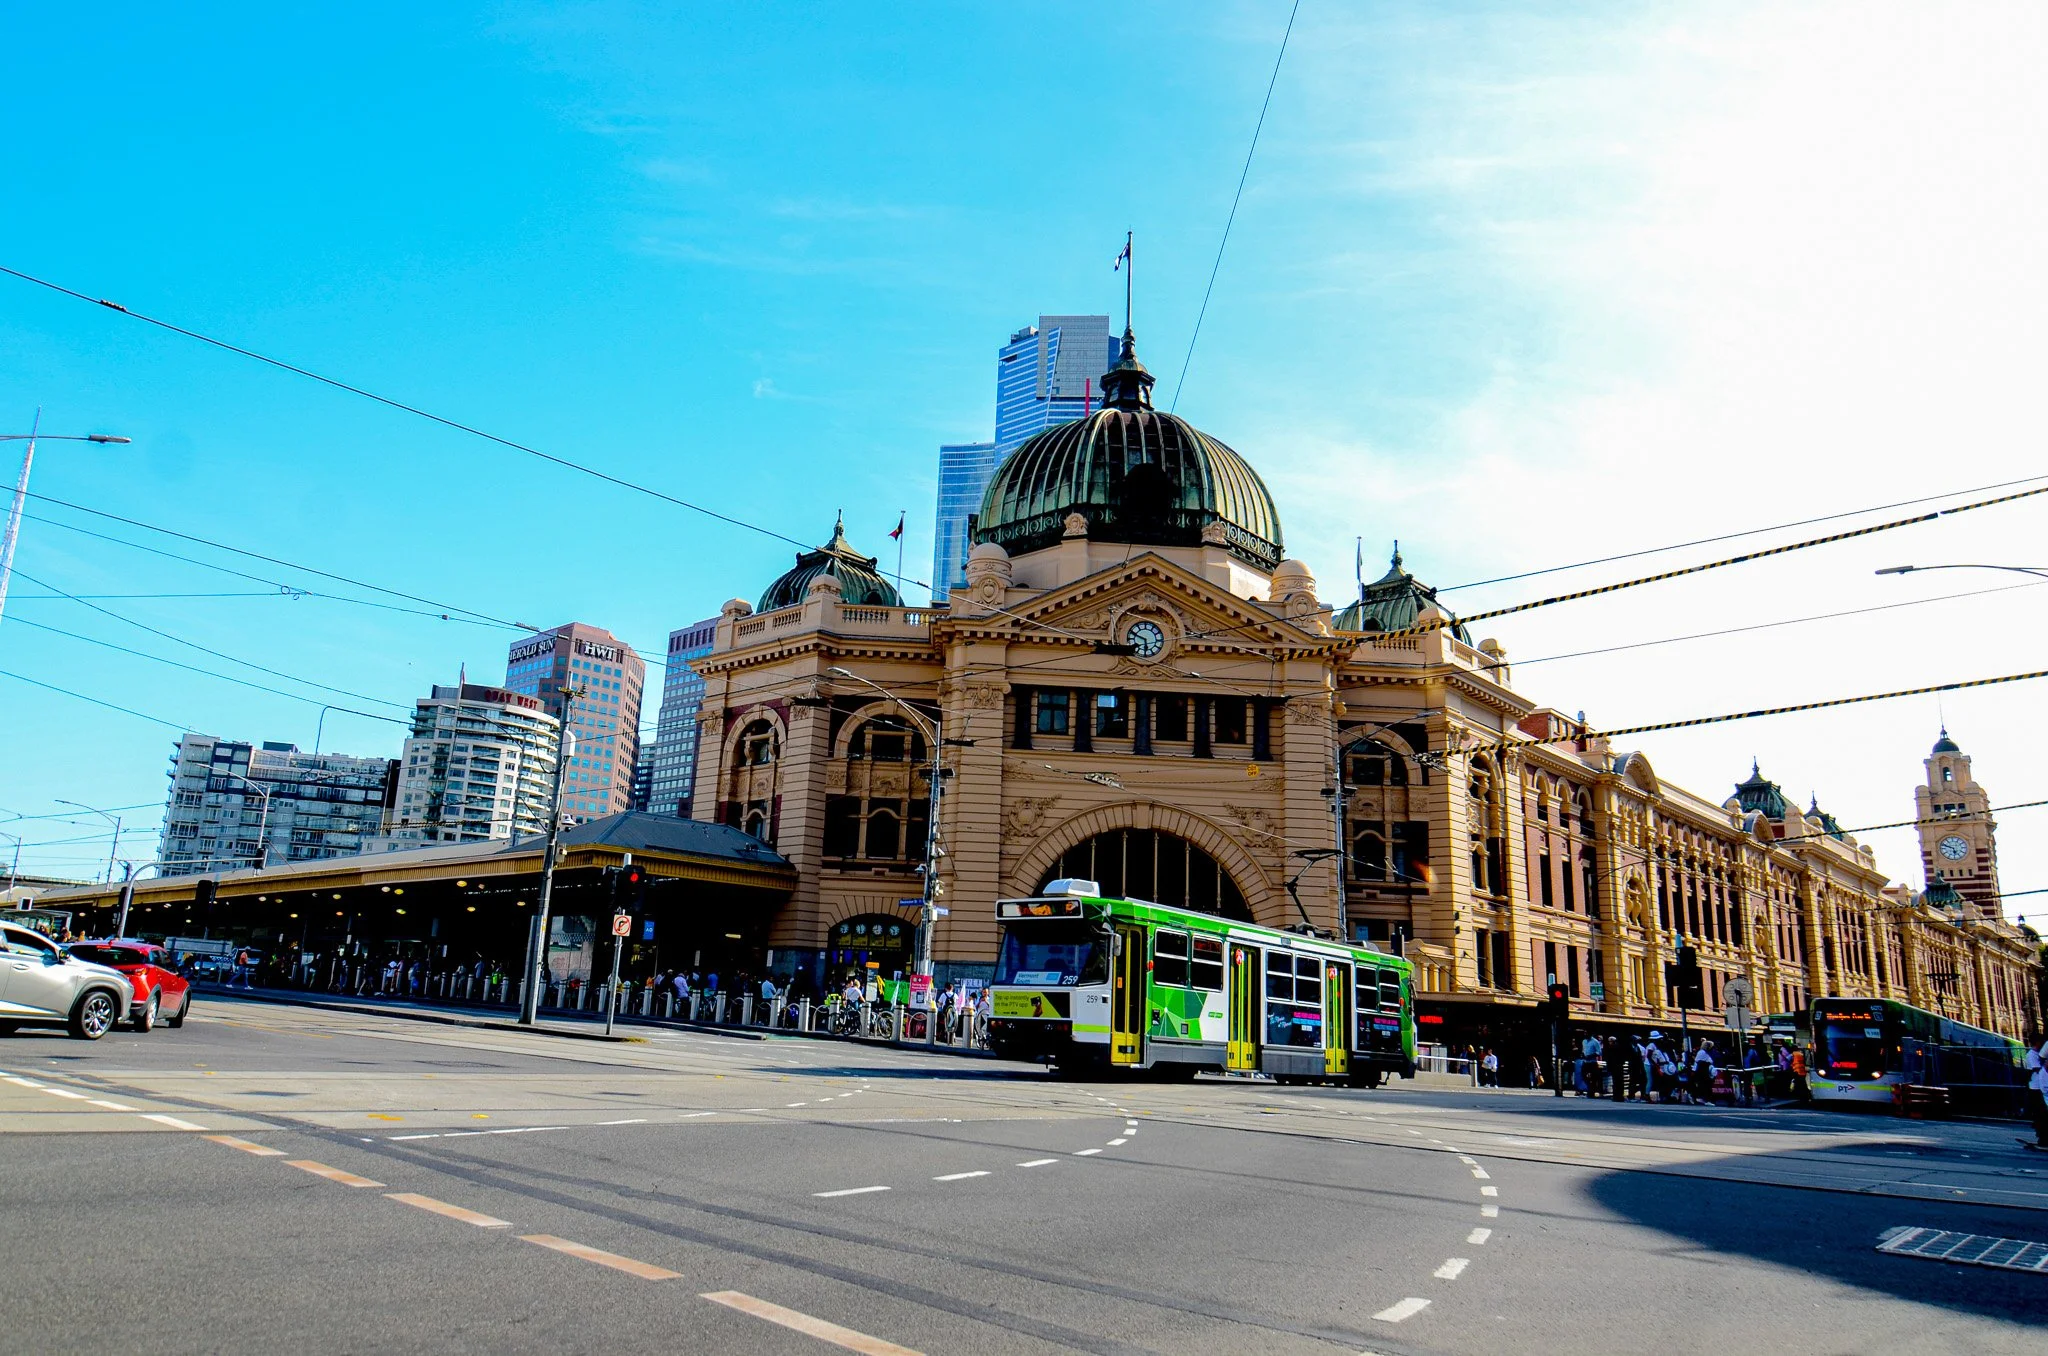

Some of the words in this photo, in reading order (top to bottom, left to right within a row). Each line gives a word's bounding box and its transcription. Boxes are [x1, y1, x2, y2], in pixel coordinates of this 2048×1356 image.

[538, 638, 556, 653] SUN
[517, 695, 538, 710] WEST
[1062, 975, 1078, 985] 259
[1086, 994, 1099, 1004] 259
